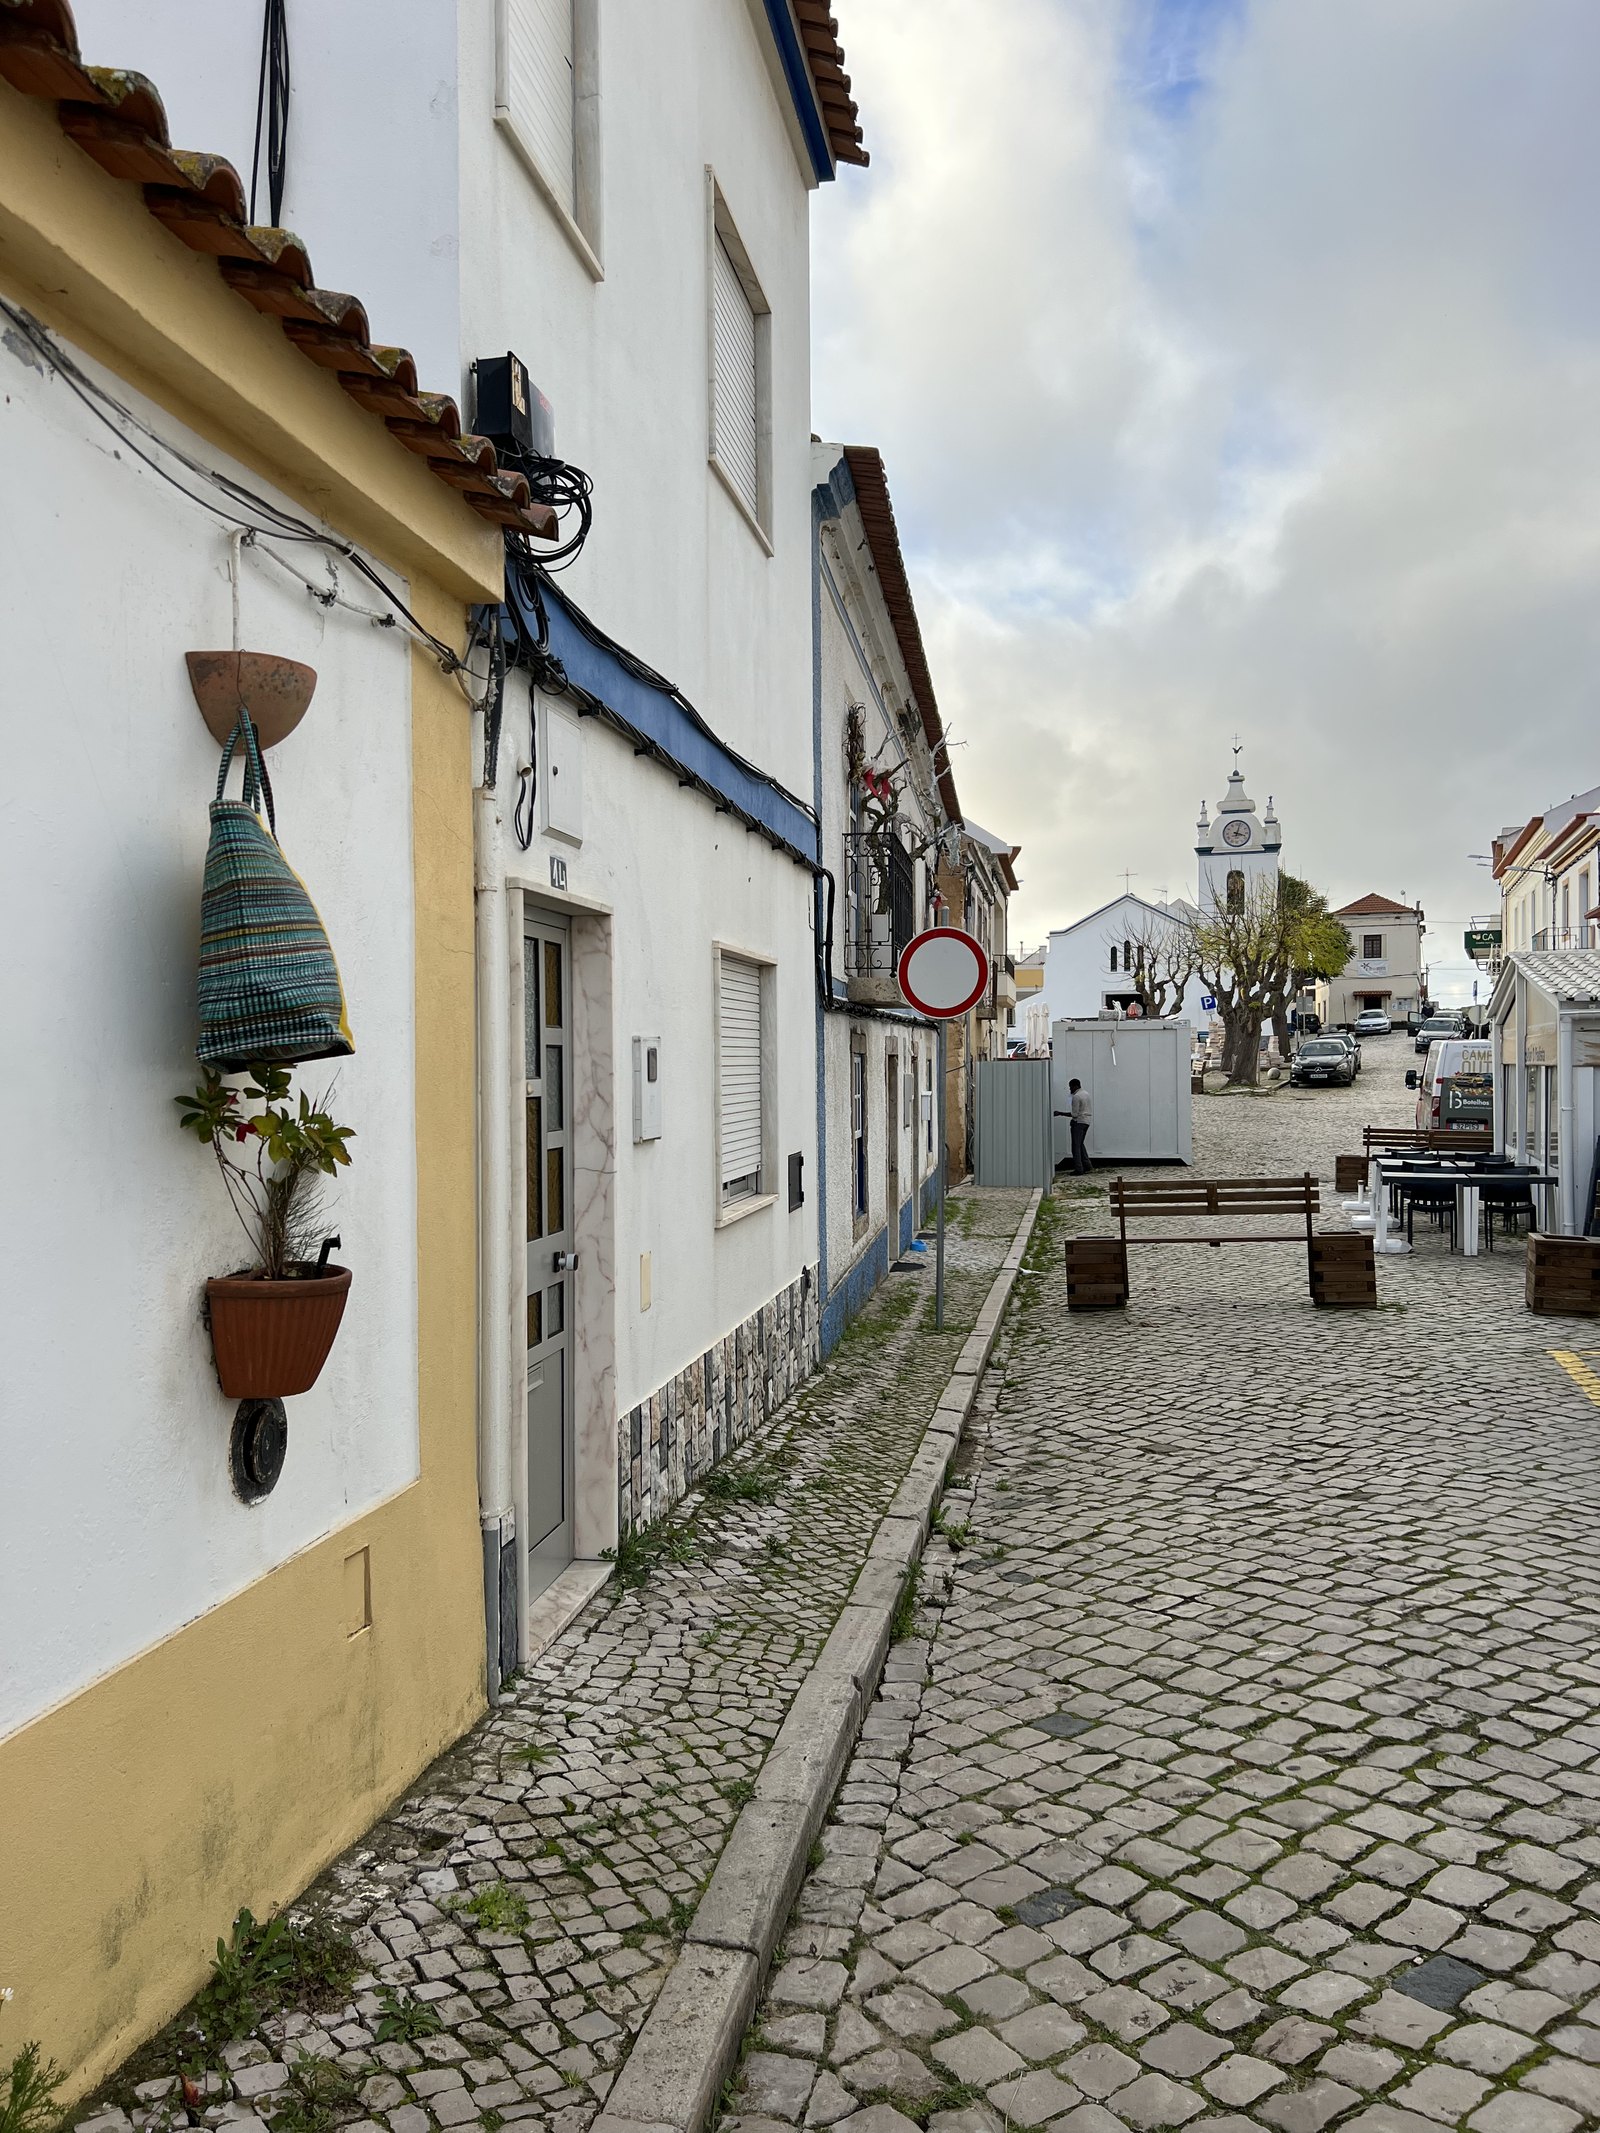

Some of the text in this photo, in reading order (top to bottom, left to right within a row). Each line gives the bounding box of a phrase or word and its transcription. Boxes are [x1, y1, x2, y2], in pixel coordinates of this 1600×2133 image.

[552, 858, 567, 891] 14
[1482, 933, 1495, 941] CA
[1203, 997, 1213, 1009] P
